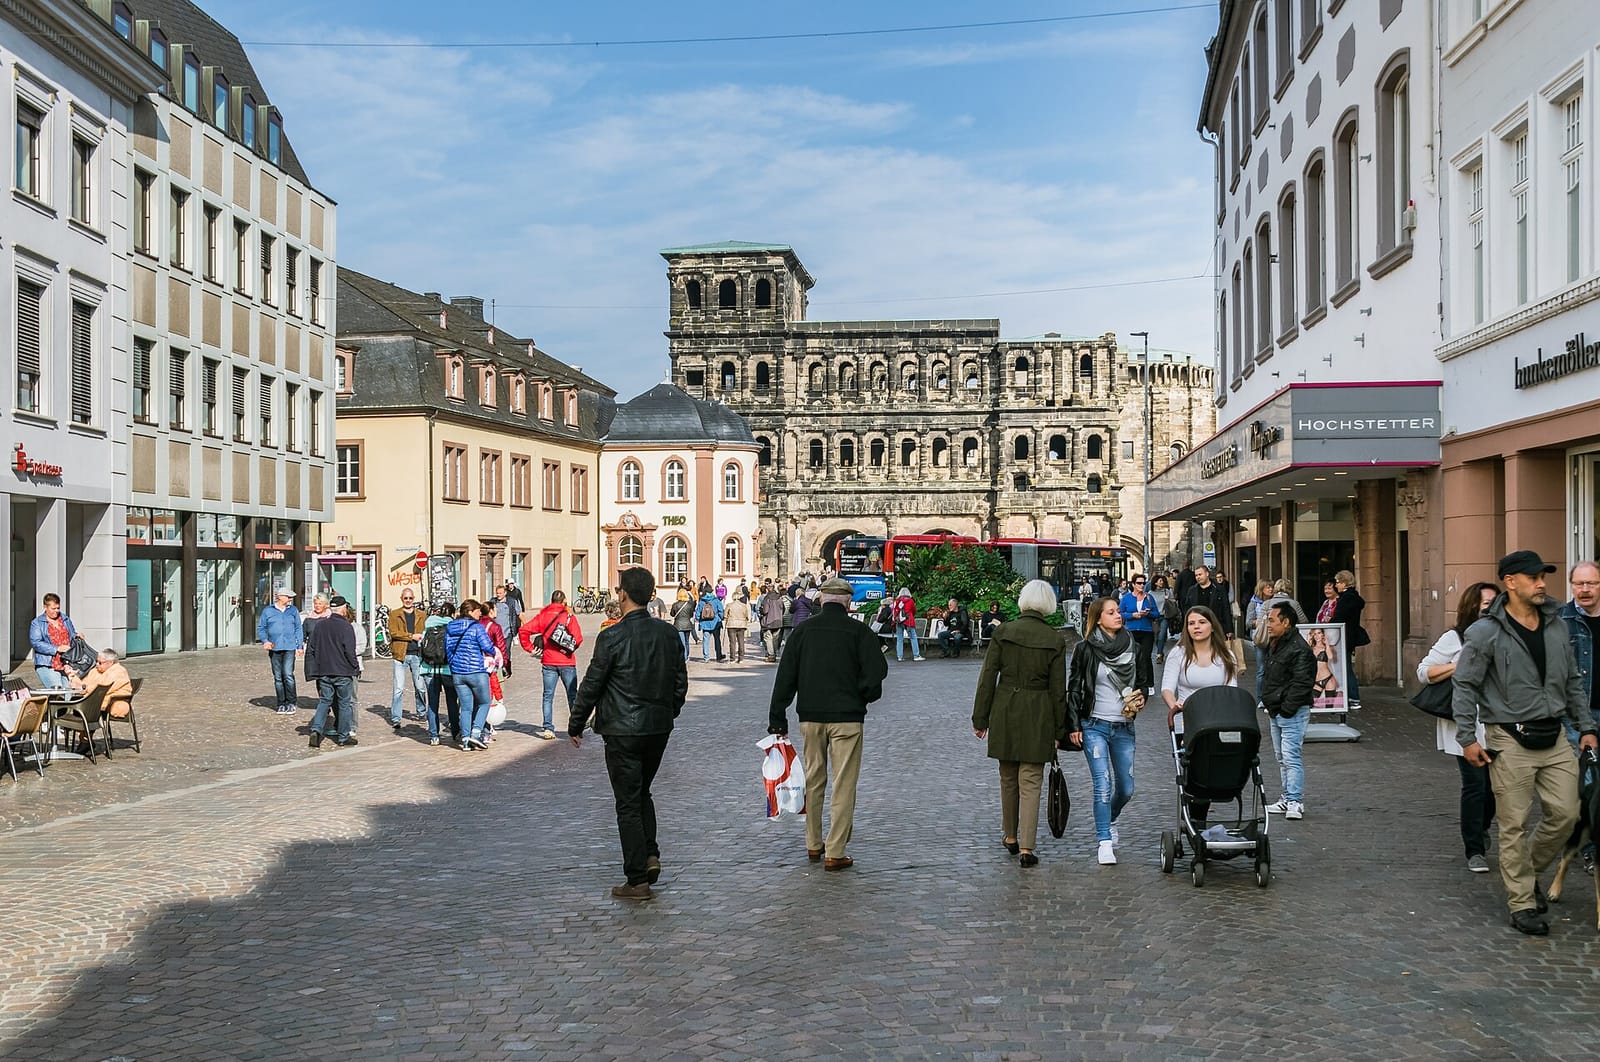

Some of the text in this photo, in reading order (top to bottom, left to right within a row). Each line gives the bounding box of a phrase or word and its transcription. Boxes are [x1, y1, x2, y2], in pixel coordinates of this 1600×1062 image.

[1514, 332, 1600, 389] hunkemöller
[1298, 417, 1435, 431] HOCHSTETTER
[30, 458, 63, 476] Sparkasse
[662, 515, 687, 526] THEO
